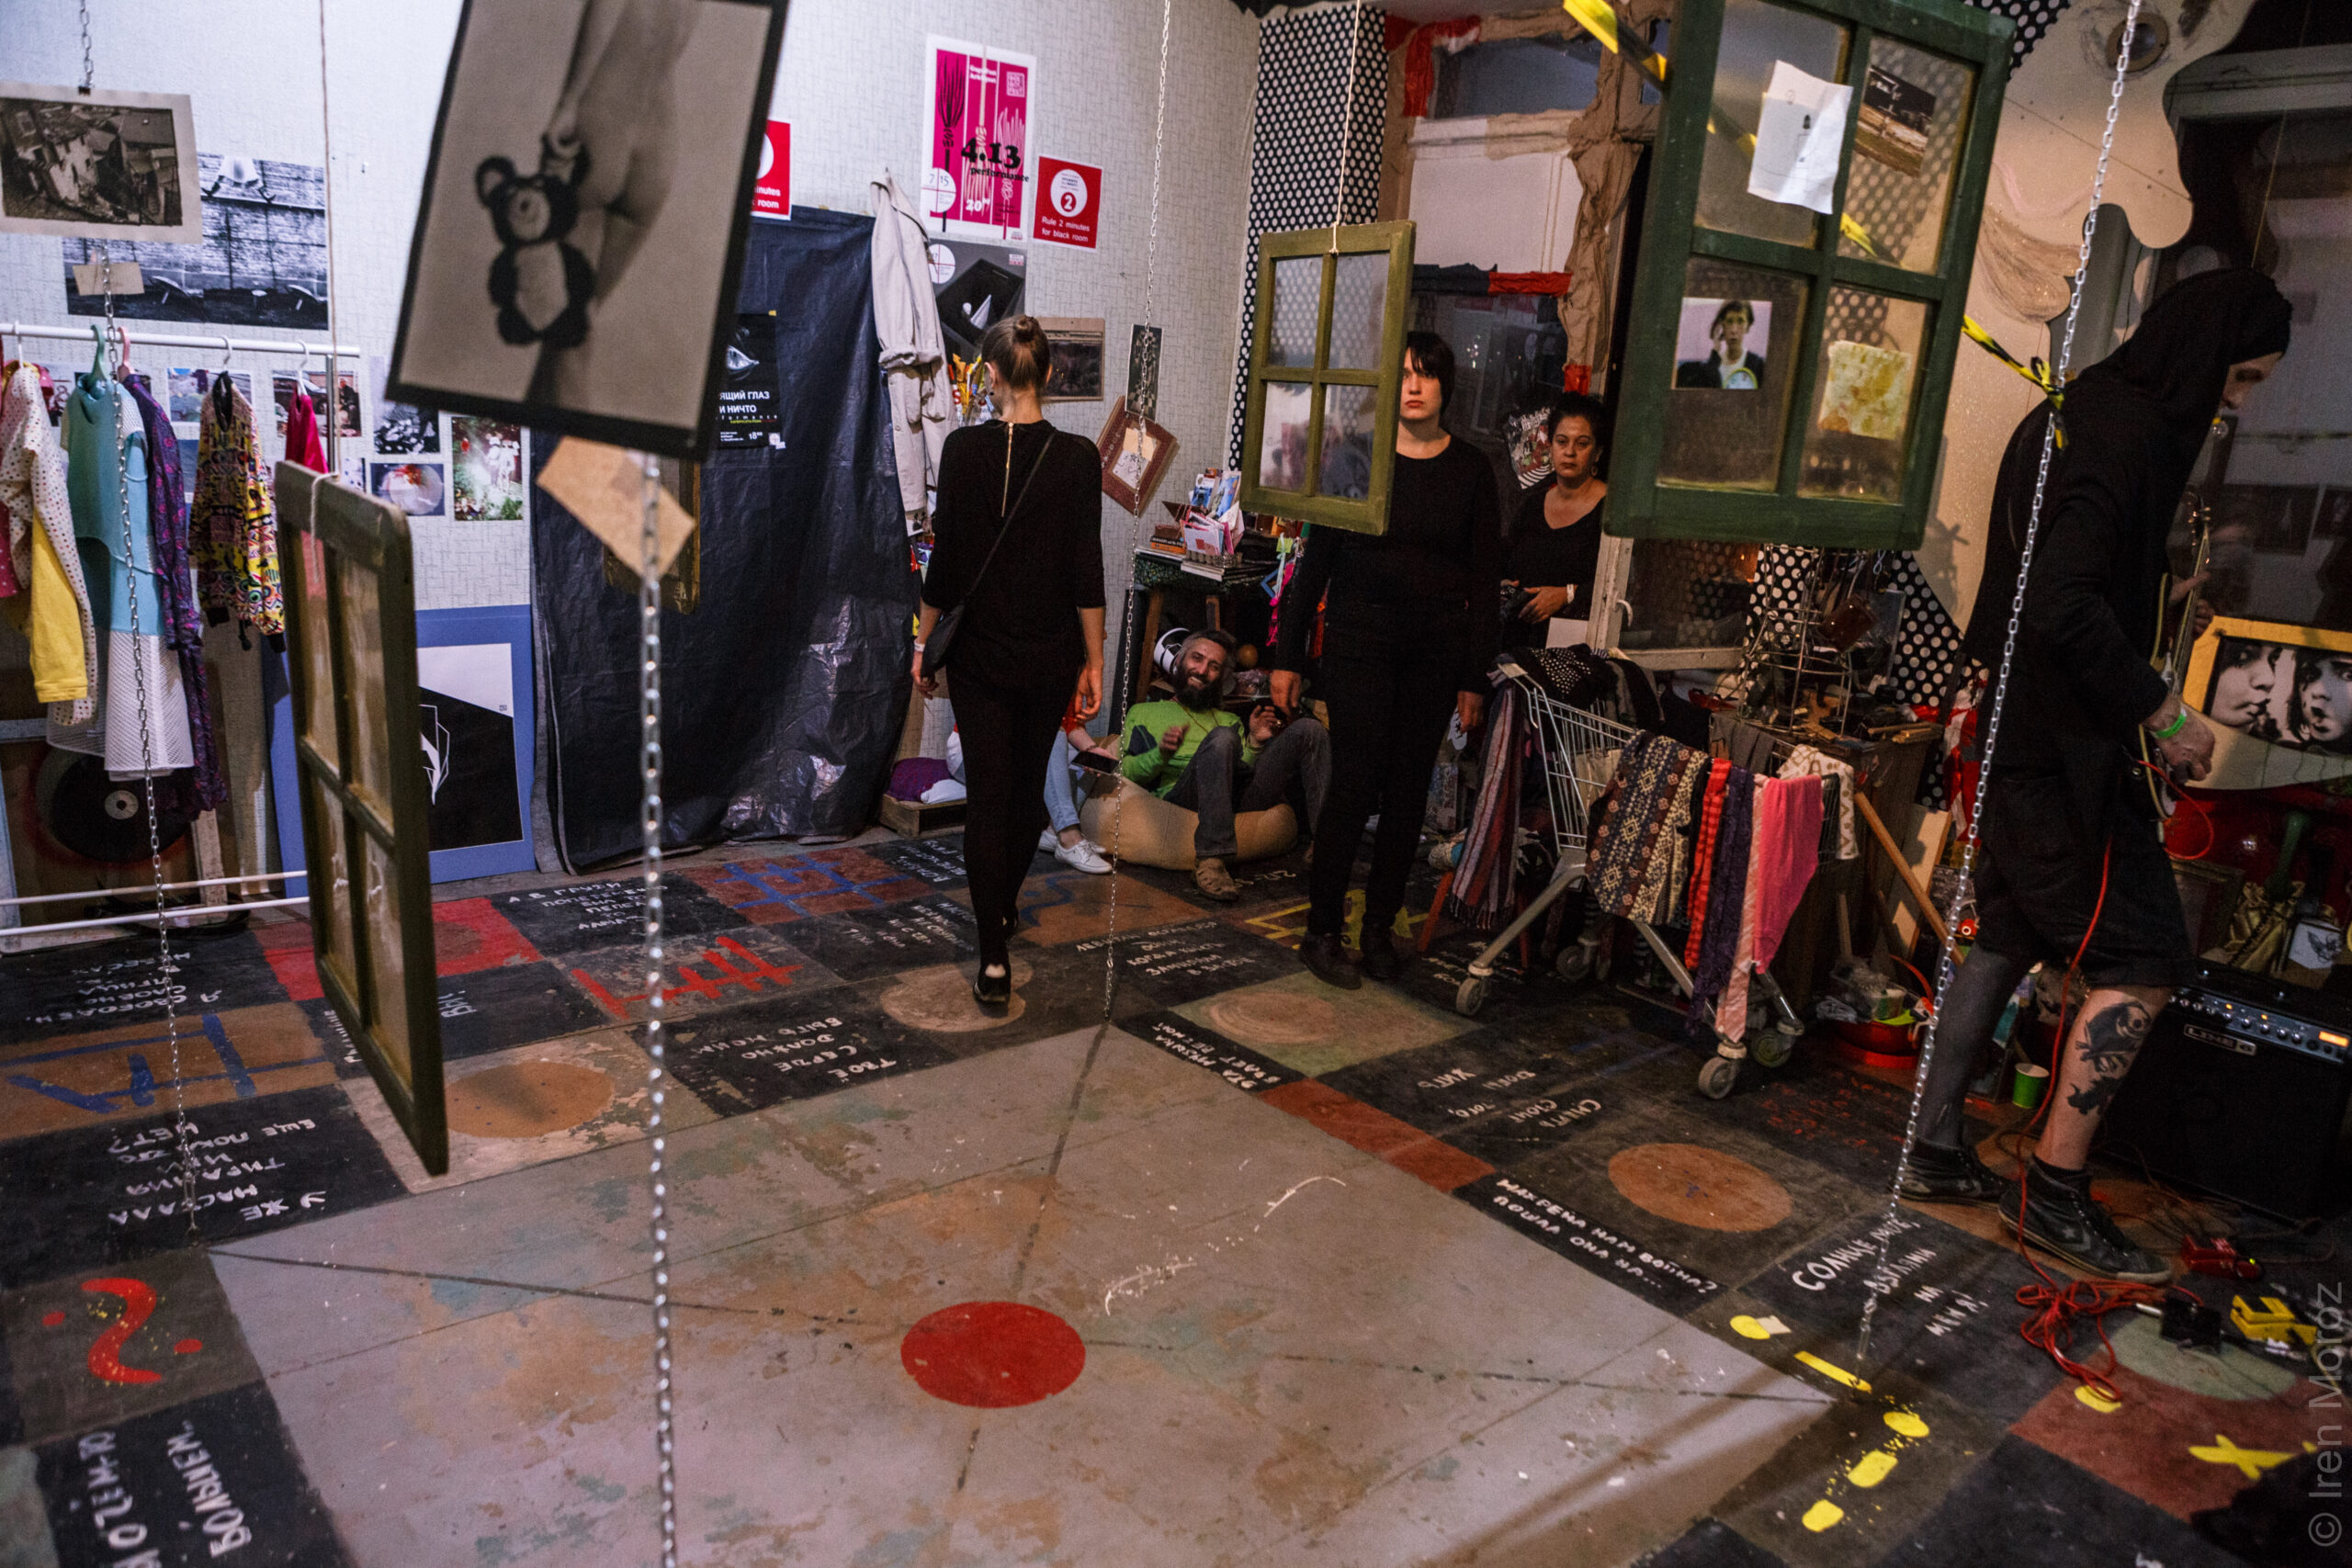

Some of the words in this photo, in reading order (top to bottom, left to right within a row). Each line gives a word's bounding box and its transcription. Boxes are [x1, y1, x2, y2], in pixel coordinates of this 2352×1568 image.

[961, 138, 1021, 169] 4.13
[970, 166, 1029, 184] performance
[754, 186, 781, 197] inutes
[758, 198, 779, 209] room
[1064, 194, 1073, 210] 2
[1042, 216, 1057, 226] Rule
[1058, 219, 1064, 227] 2
[1066, 221, 1091, 232] minutes
[1053, 230, 1070, 239] black
[1072, 234, 1089, 243] room
[747, 390, 771, 400] ГЛАЗ
[727, 404, 757, 413] НИЧТО
[200, 989, 222, 1003] Я
[777, 1017, 843, 1036] БЫТЬ
[262, 1118, 316, 1137] ЕЩЕ
[1493, 1195, 1561, 1235] ПОШЛА
[1569, 1235, 1609, 1259] ОНА
[1590, 1227, 1636, 1254] НАМ
